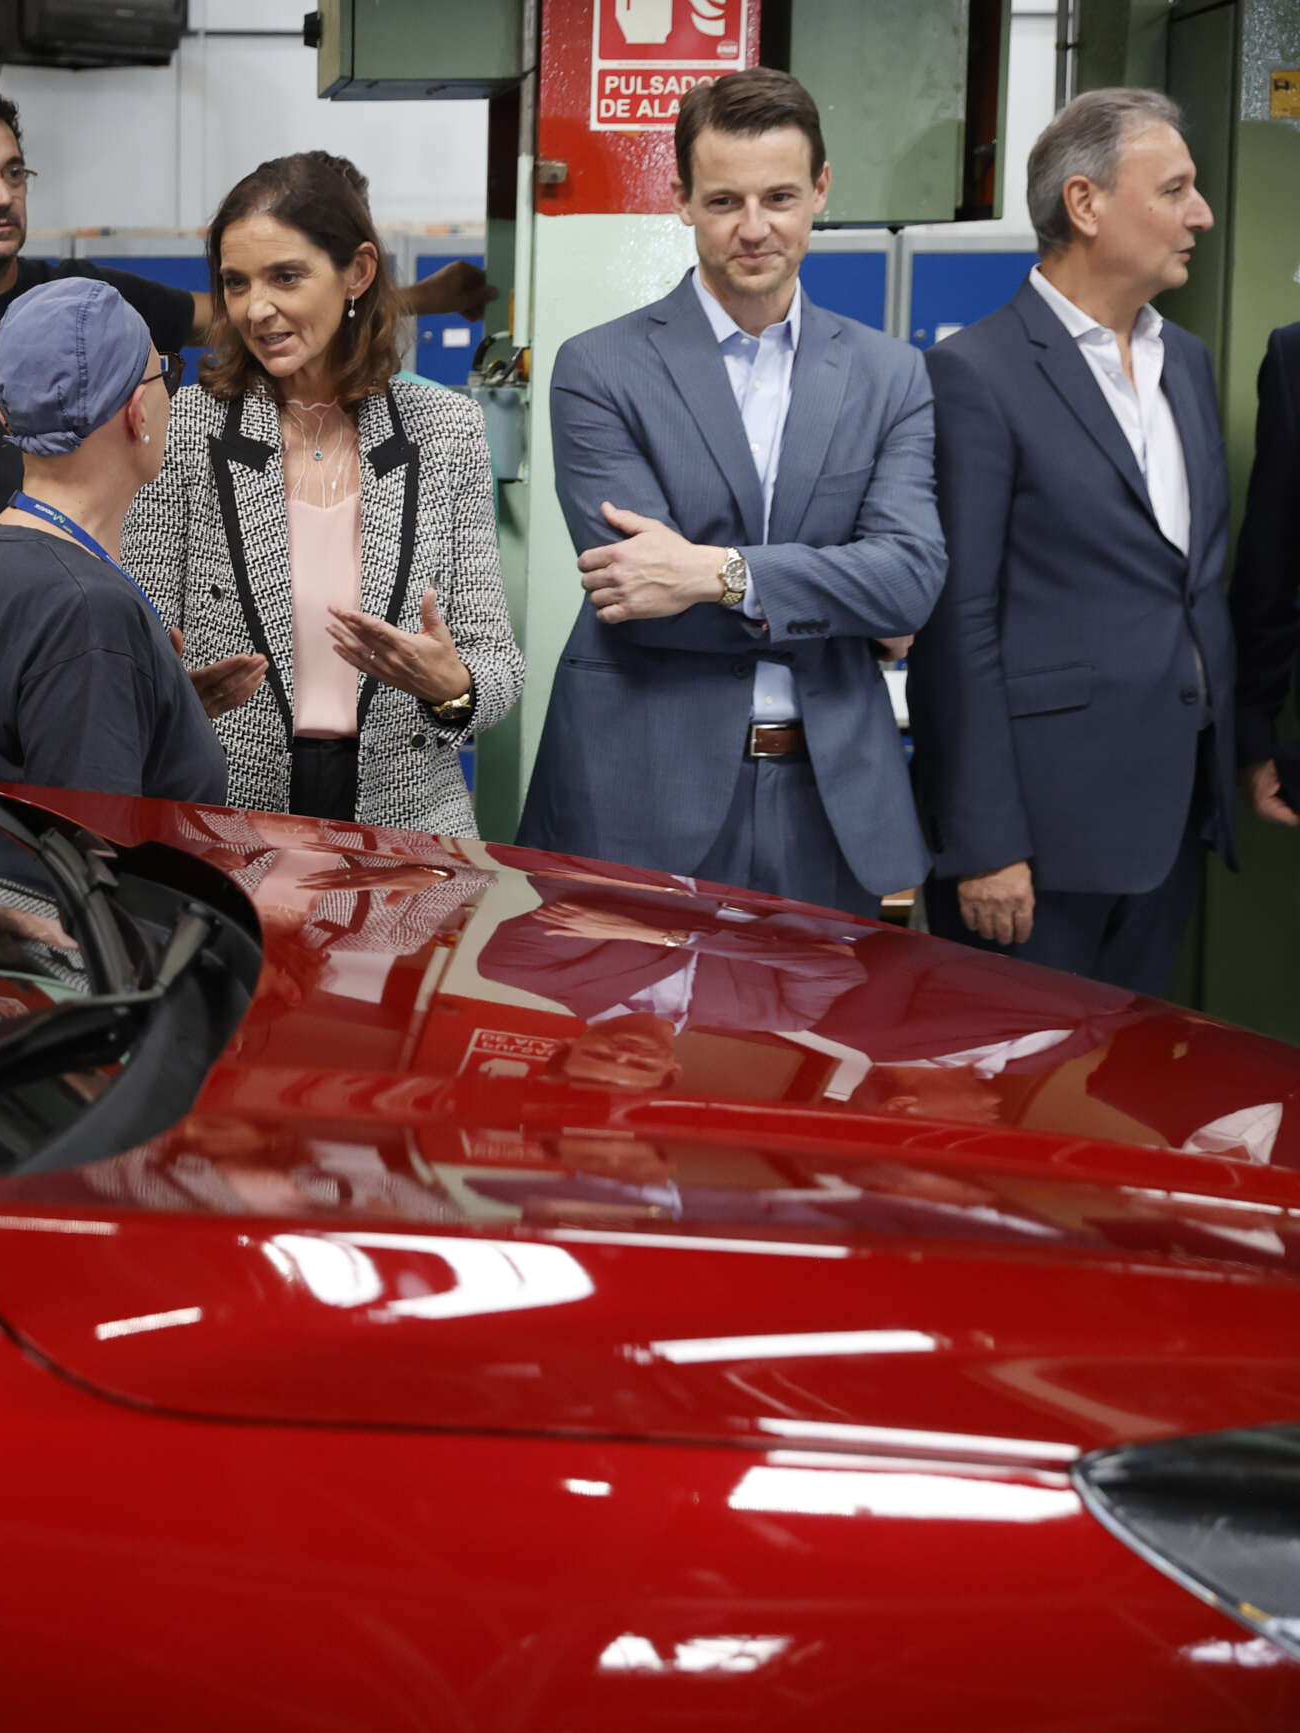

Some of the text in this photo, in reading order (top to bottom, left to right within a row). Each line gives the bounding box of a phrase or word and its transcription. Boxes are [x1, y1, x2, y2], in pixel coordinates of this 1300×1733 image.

[604, 75, 721, 95] PULSADO
[600, 99, 680, 117] DE ALA
